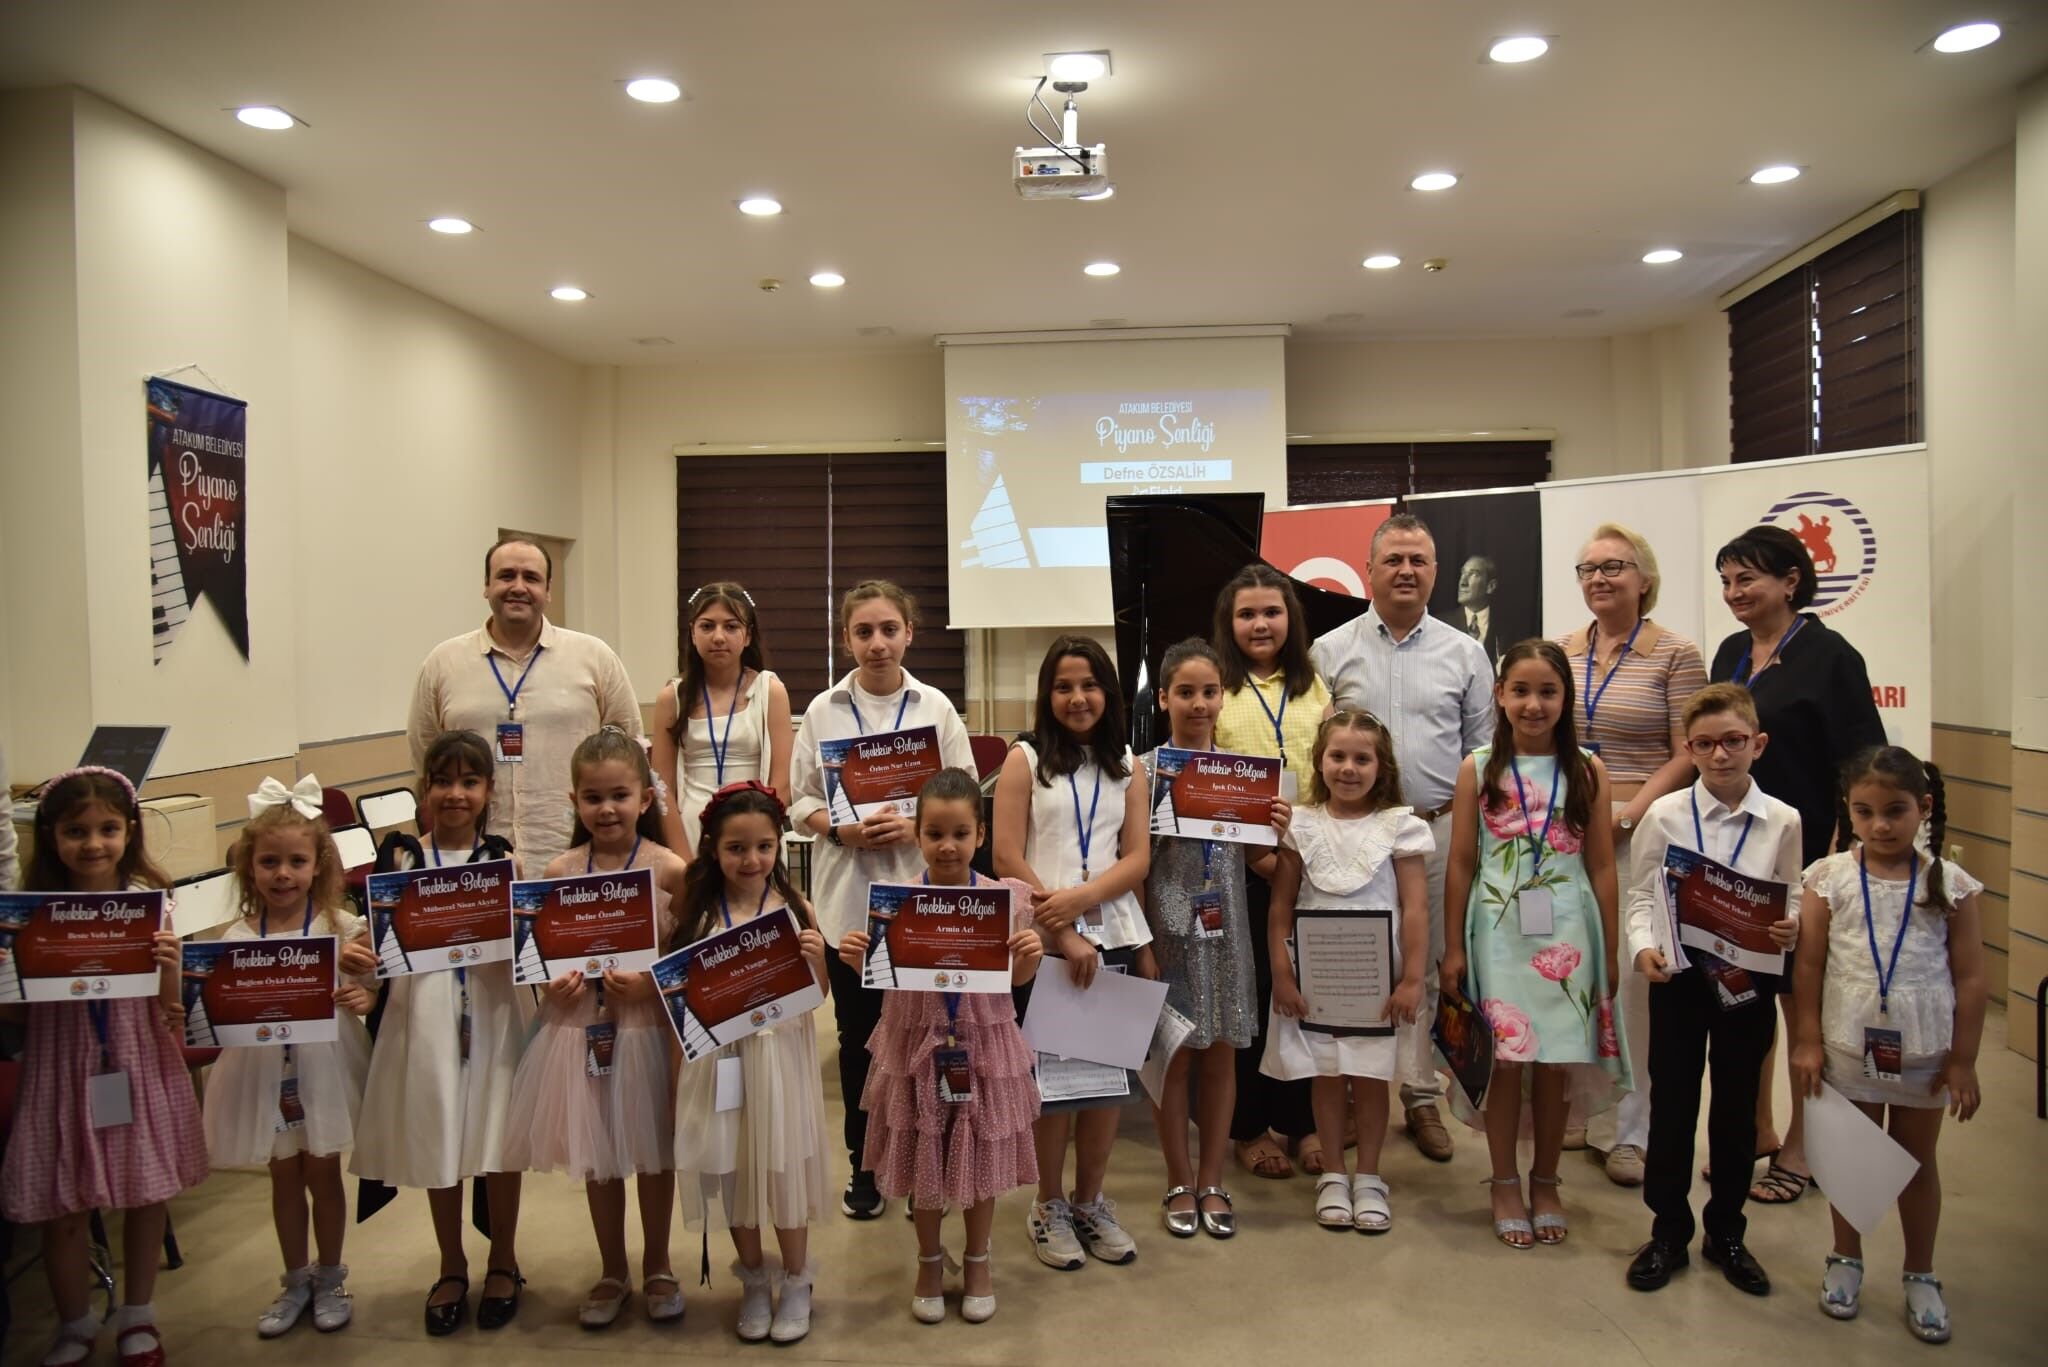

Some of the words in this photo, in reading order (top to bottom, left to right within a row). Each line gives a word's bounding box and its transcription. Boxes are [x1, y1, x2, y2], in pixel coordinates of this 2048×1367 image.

[1119, 402, 1150, 414] ATAKUM
[1151, 400, 1192, 414] BELEDİYESİ
[172, 429, 205, 450] ATAKUM
[205, 435, 244, 458] BELEDİYESİ
[1096, 416, 1157, 453] Piyano
[1159, 414, 1216, 452] Şenliği
[179, 451, 238, 510] Piyano
[1104, 467, 1145, 480] Defne
[1148, 462, 1206, 479] ÖZSALİH
[182, 502, 236, 563] Şenliği
[1194, 758, 1232, 776] Teşekkür
[1234, 760, 1268, 782] Belgesi
[413, 876, 459, 898] Teşekkür
[460, 871, 500, 893] Belgesi
[555, 886, 600, 907] Teşekkür
[601, 881, 639, 903] Belgesi
[575, 913, 597, 921] Defne
[912, 894, 956, 916] Teşekkür
[958, 895, 996, 920] Belgesi
[229, 948, 276, 970] Teşekkür
[279, 946, 320, 970] Belgesi
